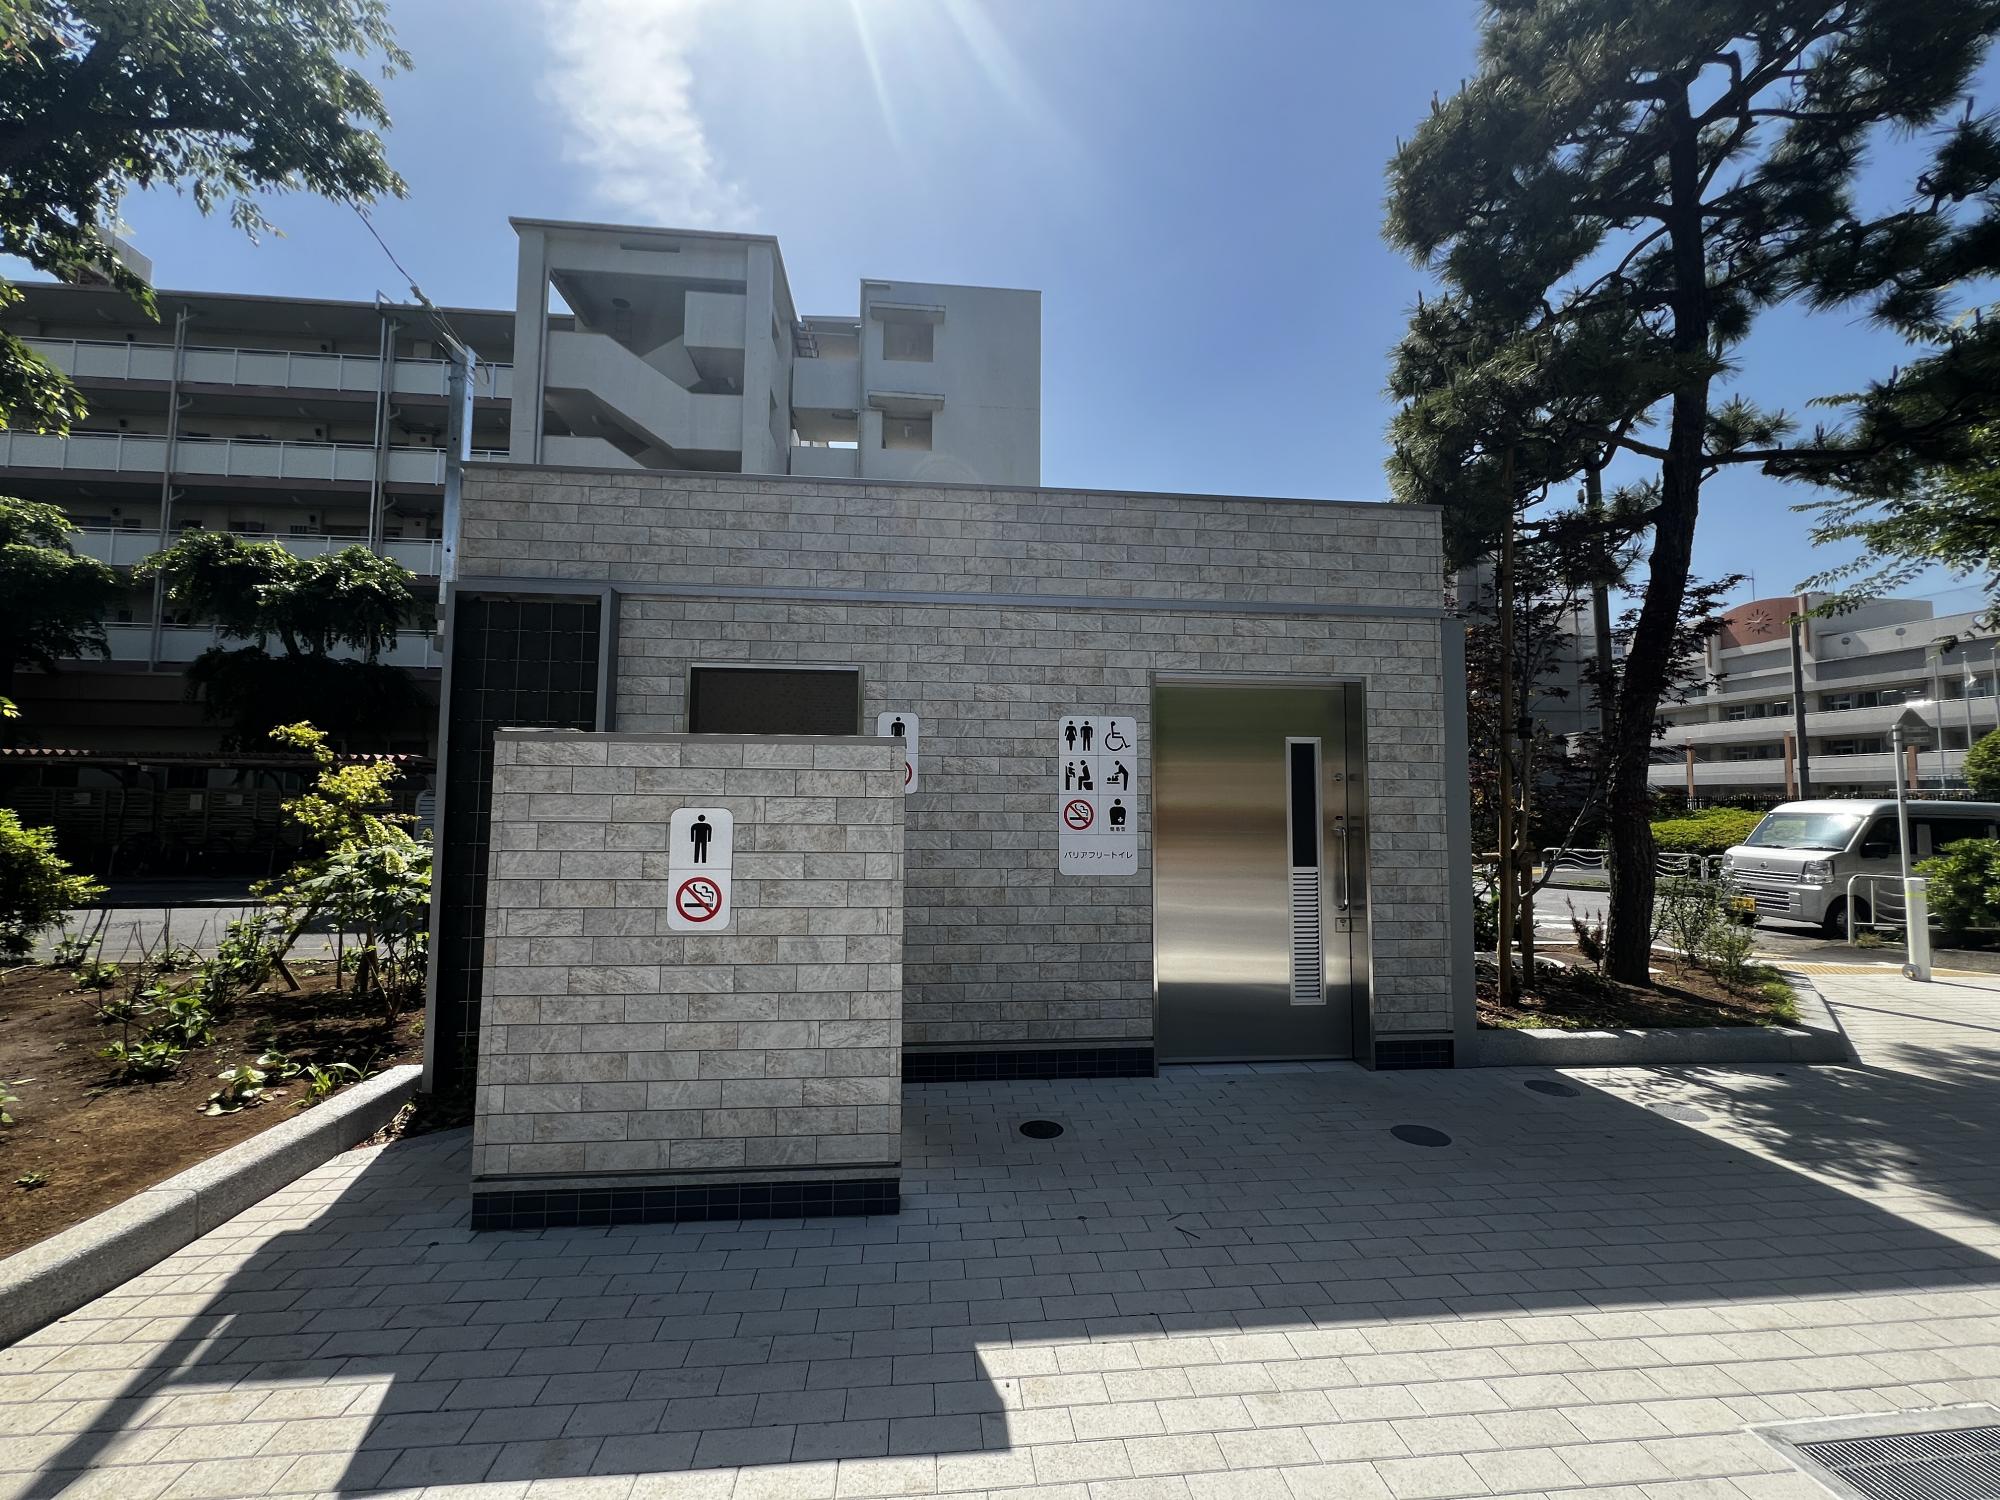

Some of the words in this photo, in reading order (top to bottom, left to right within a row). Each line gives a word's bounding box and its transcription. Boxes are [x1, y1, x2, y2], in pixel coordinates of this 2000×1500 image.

[1064, 851, 1133, 859] バリアフリートイレ
